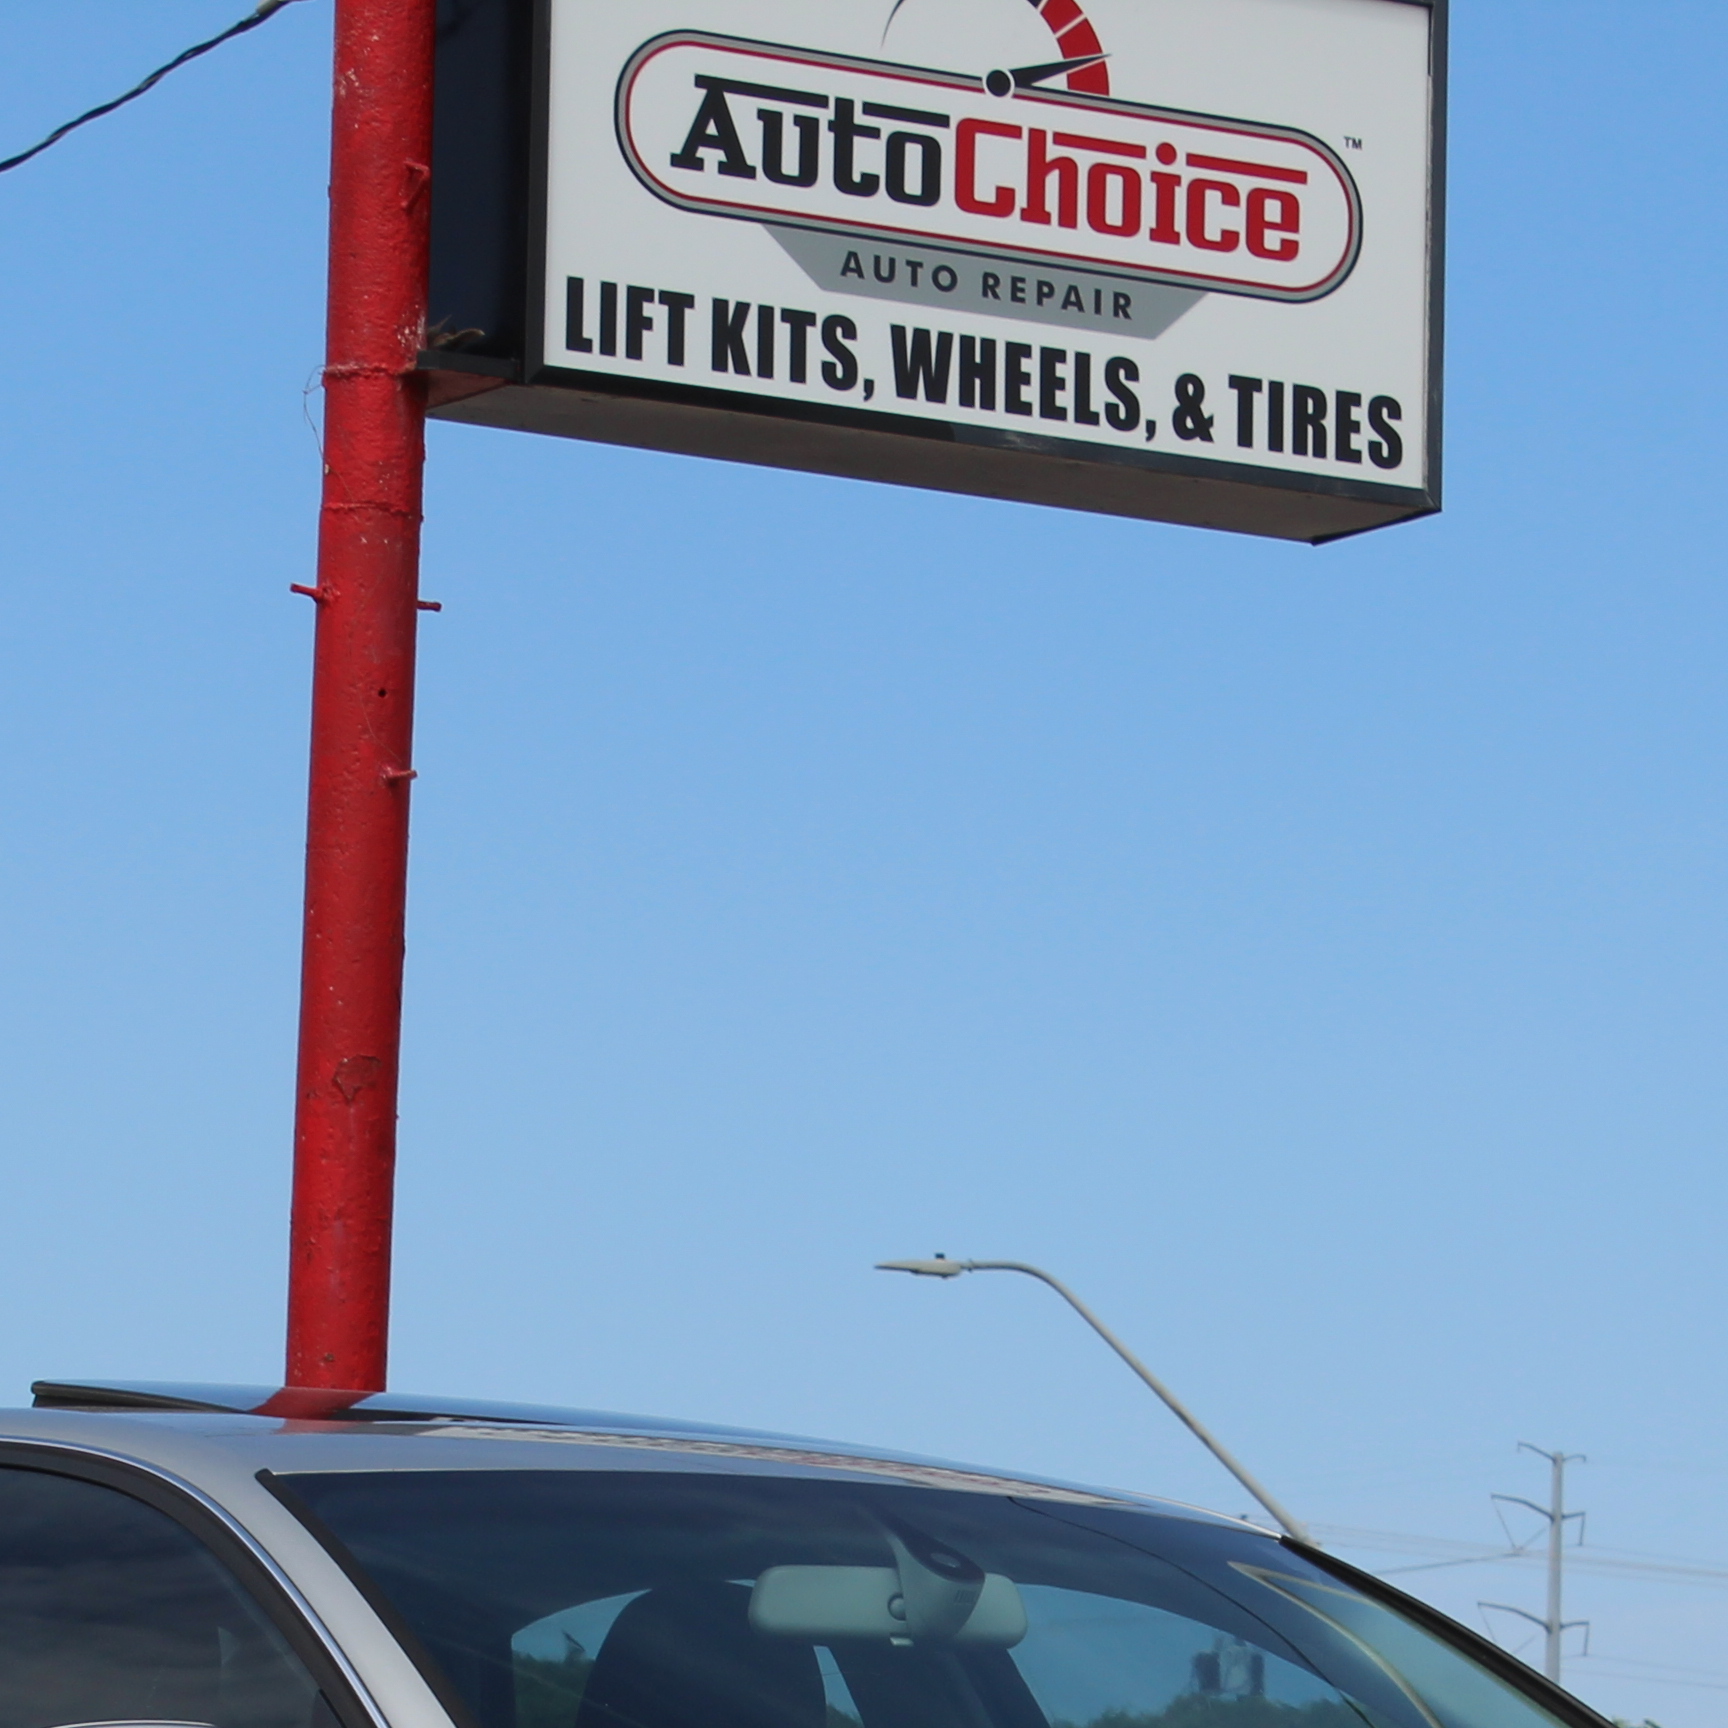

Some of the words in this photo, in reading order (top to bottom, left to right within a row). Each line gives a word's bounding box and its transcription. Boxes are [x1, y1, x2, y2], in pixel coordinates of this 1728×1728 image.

[840, 250, 959, 293] AUTO
[981, 271, 1133, 320] REPAIR
[565, 275, 695, 367] LIFT
[711, 297, 876, 402] KITS,
[889, 323, 1157, 442] WHEELS,
[1172, 372, 1215, 443] &
[1227, 373, 1404, 470] TIRES
